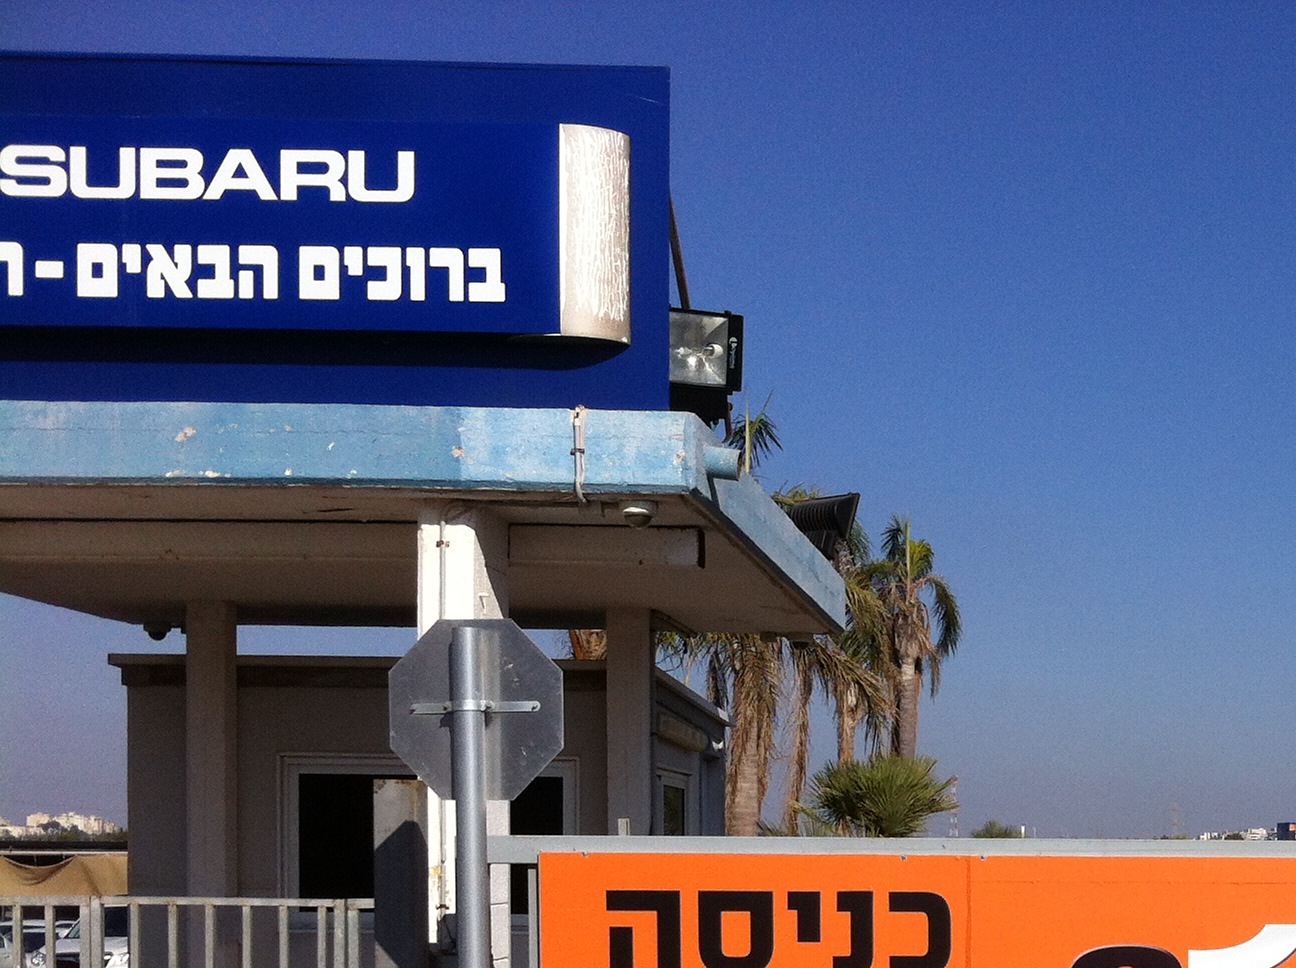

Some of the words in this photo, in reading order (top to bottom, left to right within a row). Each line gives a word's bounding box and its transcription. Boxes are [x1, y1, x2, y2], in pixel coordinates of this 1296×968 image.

[0, 145, 414, 202] SUBARU
[77, 243, 278, 299] הבאים
[299, 246, 505, 302] ברוכים
